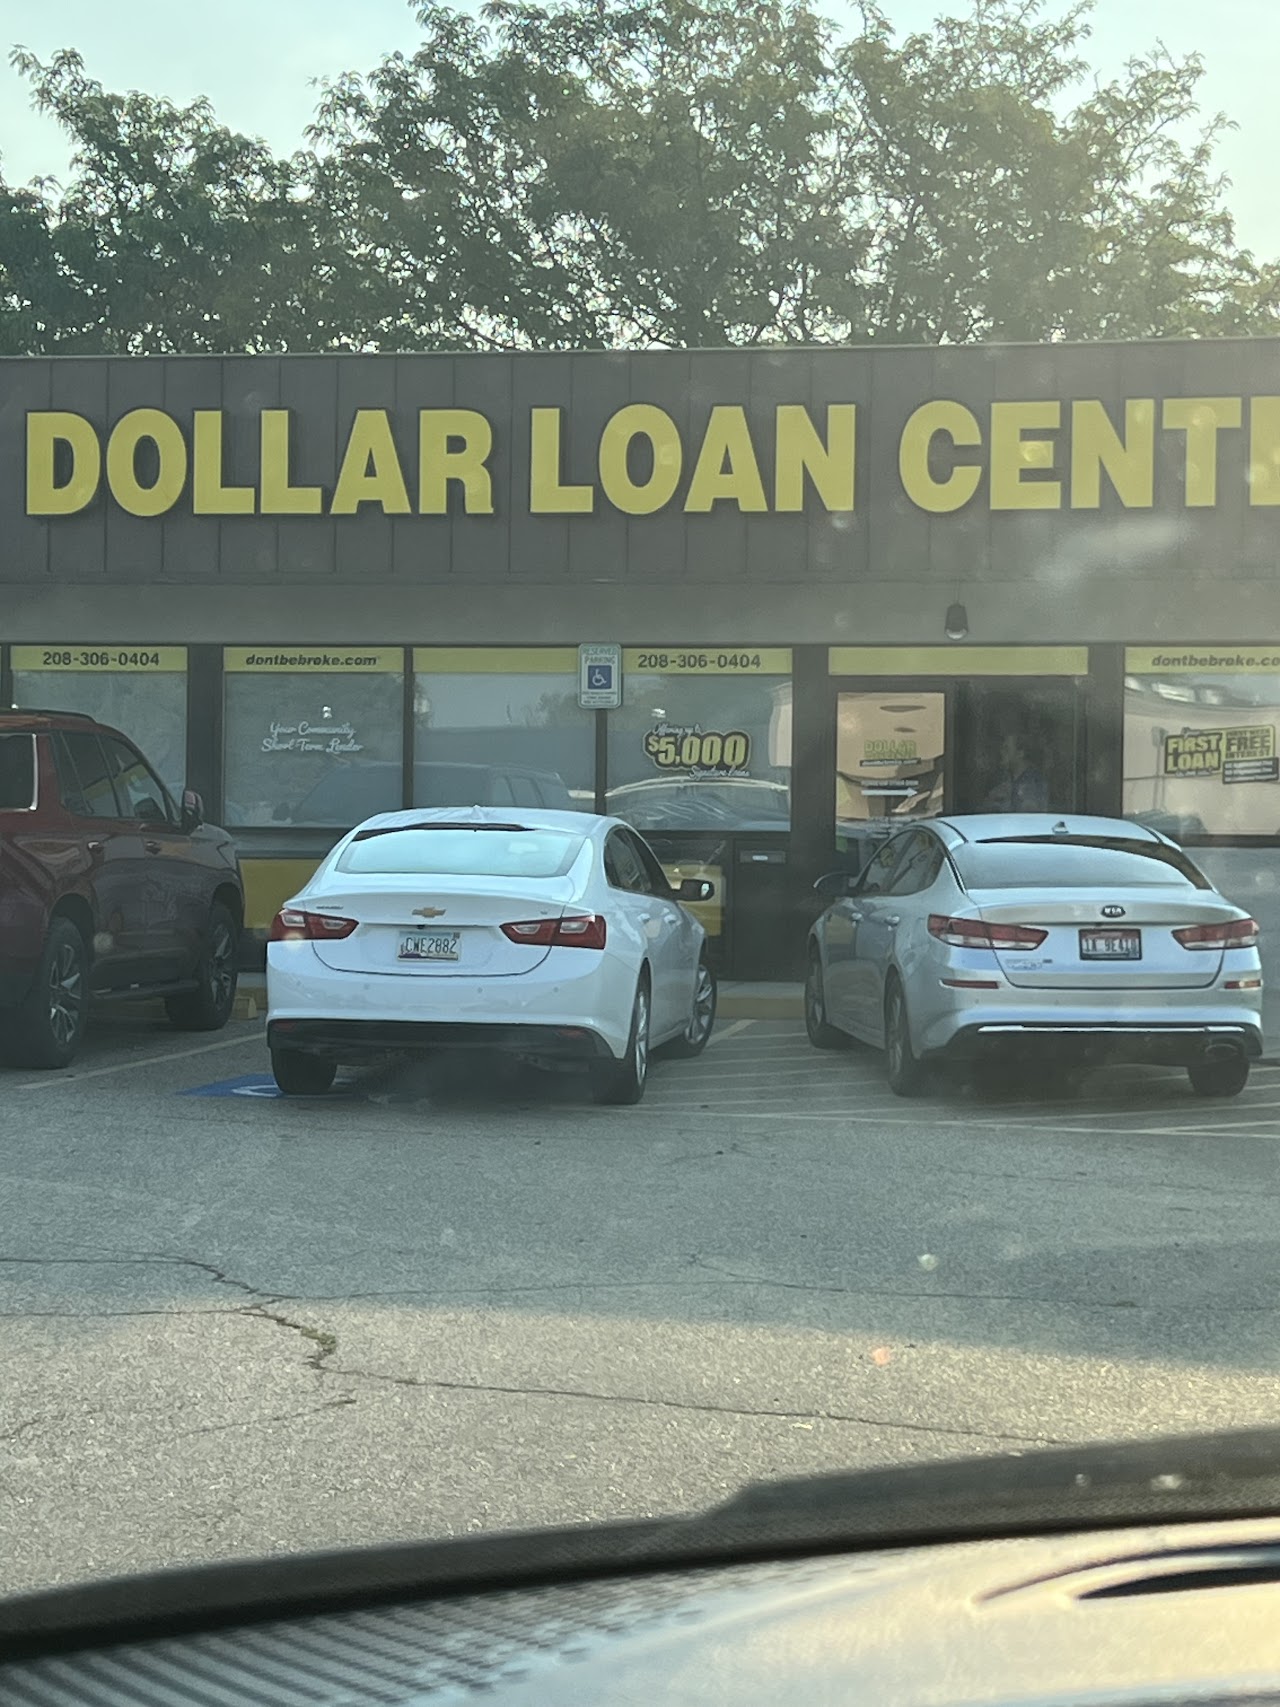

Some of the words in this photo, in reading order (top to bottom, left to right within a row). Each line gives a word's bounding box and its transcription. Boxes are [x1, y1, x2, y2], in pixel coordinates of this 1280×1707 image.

[26, 408, 494, 516] DOLLAR
[530, 403, 856, 515] LOAN
[43, 652, 160, 666] 208-306-0404
[246, 654, 377, 666] dontbebroke.com
[584, 655, 615, 664] PARKING
[638, 654, 761, 669] 208-306-0404
[298, 721, 356, 739] Community
[648, 735, 747, 766] $5,000
[1167, 735, 1219, 753] FIRST
[1226, 735, 1271, 752] FREE
[1166, 752, 1219, 772] LOAN
